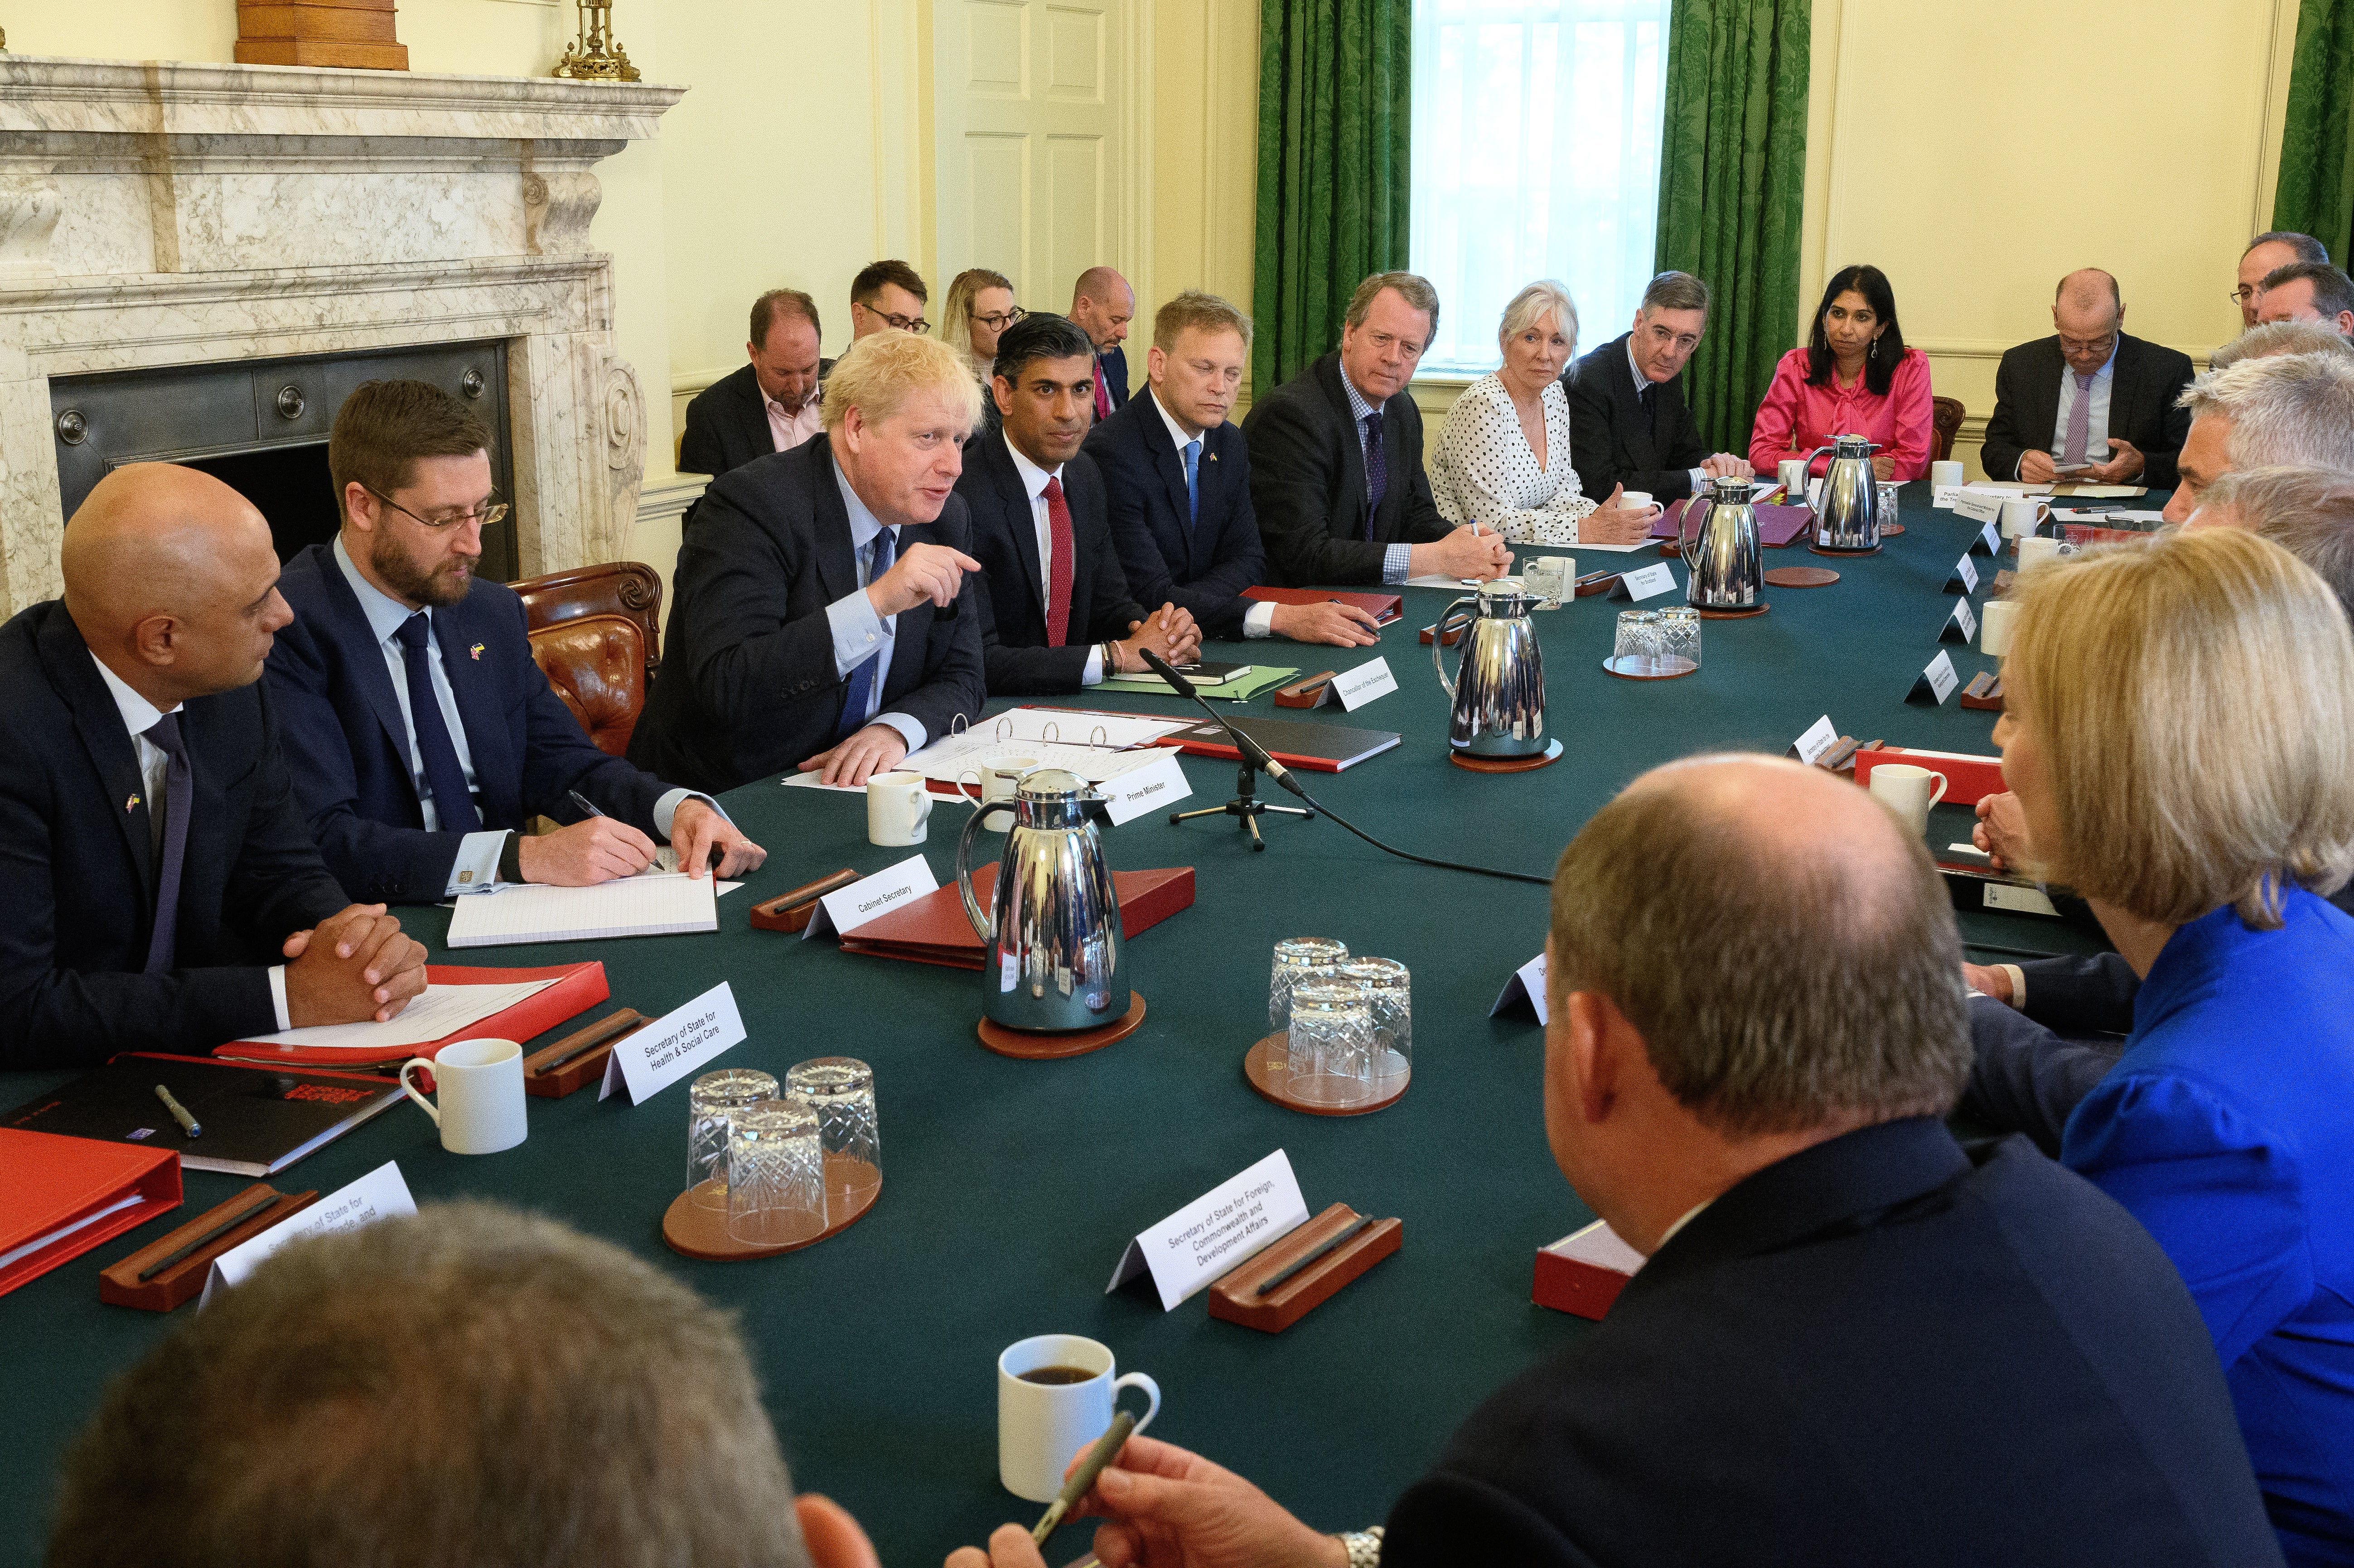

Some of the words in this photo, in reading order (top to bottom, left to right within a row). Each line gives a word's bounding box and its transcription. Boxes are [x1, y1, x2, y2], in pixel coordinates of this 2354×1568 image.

[1343, 684, 1362, 696] Chancellor
[1370, 672, 1388, 684] Exchequer
[1126, 792, 1144, 802] Prime
[1143, 782, 1165, 795] Minister
[858, 897, 884, 912] Cabinet
[882, 885, 912, 902] Secretary
[644, 1032, 678, 1058] Secretary
[679, 1026, 687, 1038] of
[687, 1018, 706, 1033] State
[705, 1011, 716, 1023] for
[650, 1051, 674, 1071] Health
[675, 1047, 682, 1057] &
[682, 1033, 703, 1053] Social
[703, 1026, 720, 1039] Care
[324, 1204, 349, 1223] State
[348, 1196, 363, 1210] for
[358, 1205, 376, 1223] and
[1168, 1222, 1205, 1249] Secretary
[1205, 1213, 1214, 1226] of
[1213, 1204, 1233, 1221] State
[1233, 1196, 1245, 1209] for
[1244, 1180, 1275, 1201] Foreign,
[1192, 1211, 1248, 1251] Commonwealth
[1248, 1201, 1263, 1217] and
[1196, 1230, 1246, 1267] Development
[1245, 1216, 1269, 1236] Affairs
